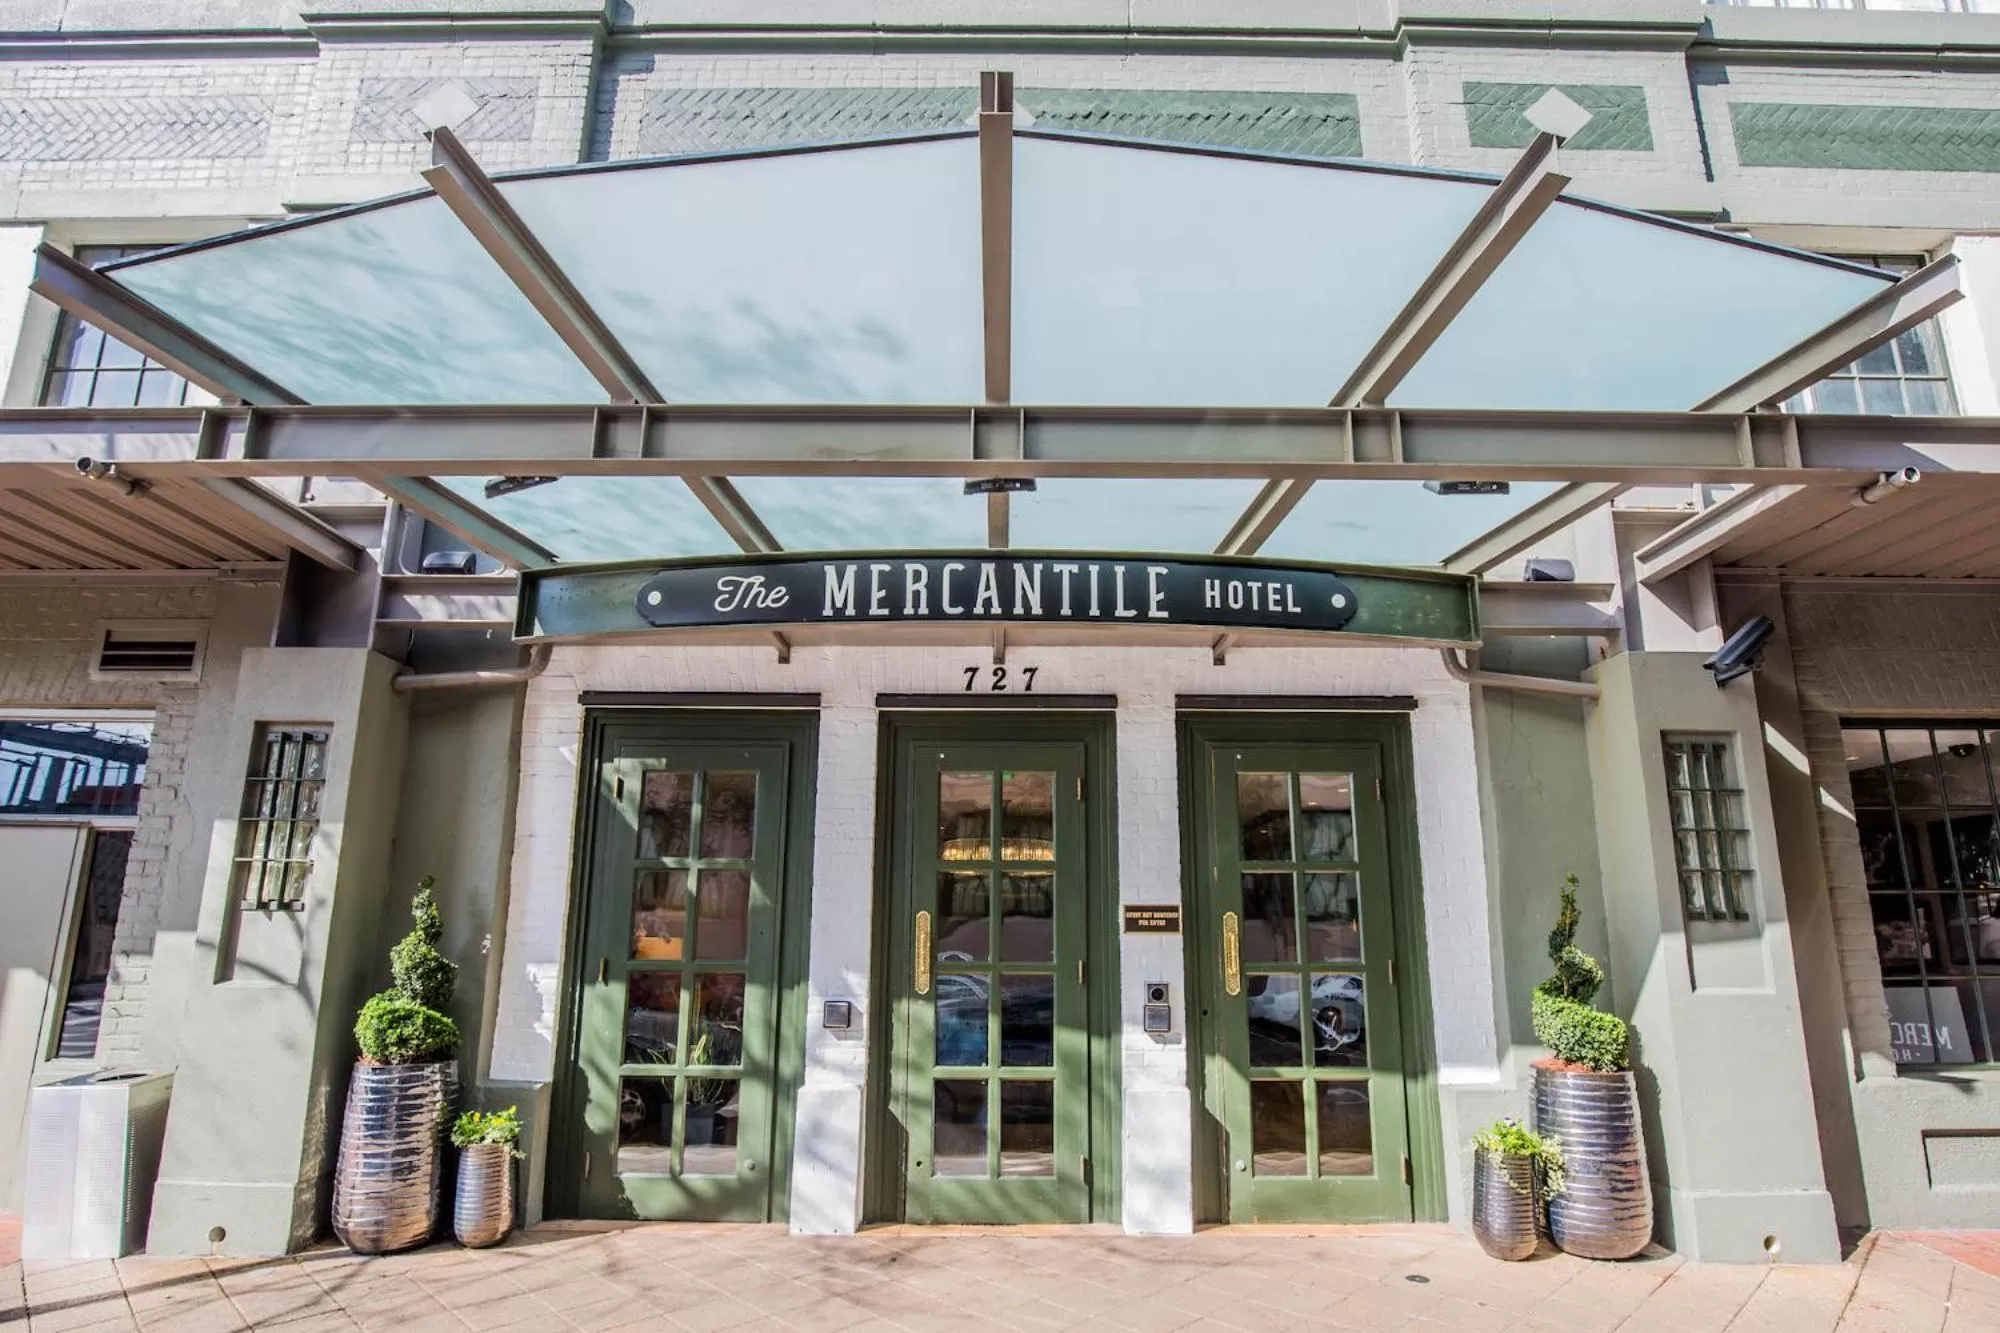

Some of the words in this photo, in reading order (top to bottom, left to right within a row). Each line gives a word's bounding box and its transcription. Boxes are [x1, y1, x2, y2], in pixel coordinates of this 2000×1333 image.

[714, 575, 790, 612] The
[822, 563, 1169, 618] MERCANTILE
[1205, 579, 1302, 613] HOTEL
[963, 667, 1038, 691] 727
